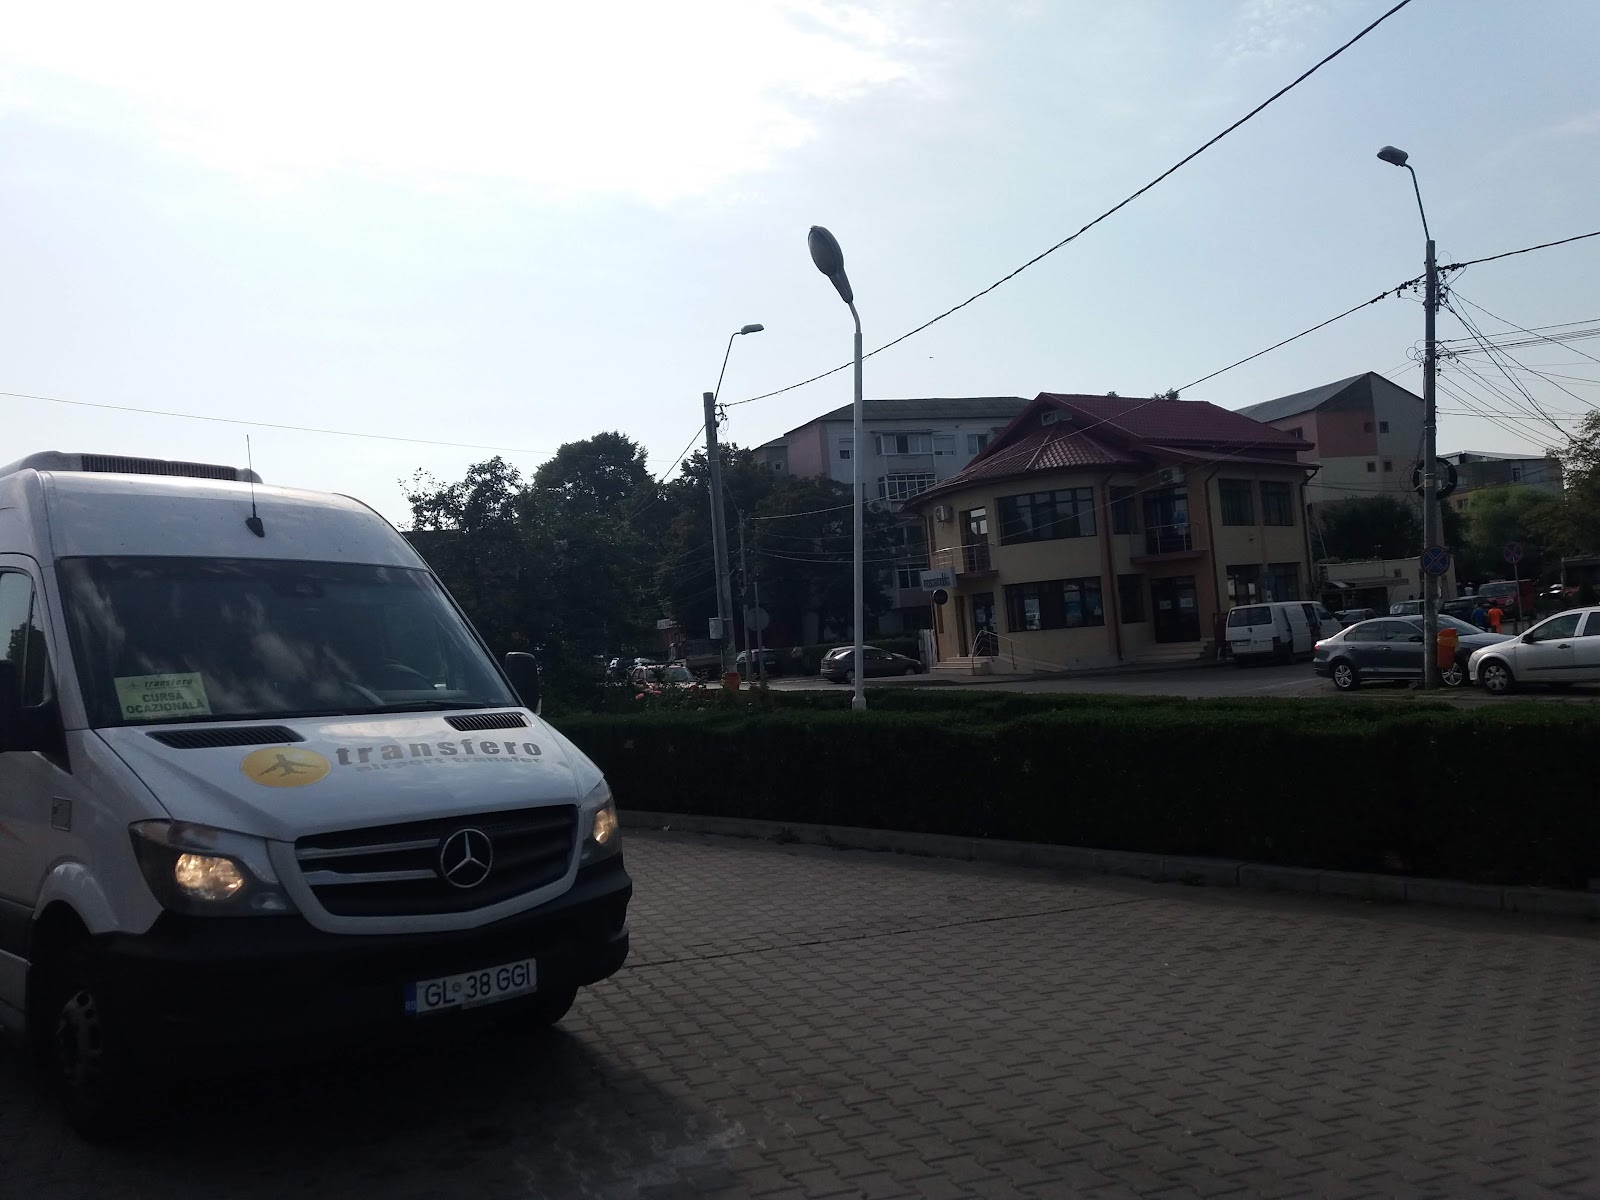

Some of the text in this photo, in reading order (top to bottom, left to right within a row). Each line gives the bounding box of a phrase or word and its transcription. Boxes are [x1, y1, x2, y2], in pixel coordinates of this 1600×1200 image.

[336, 738, 542, 766] transfero
[356, 756, 541, 772] airport transfer
[425, 962, 530, 1007] GL 38 GGI
